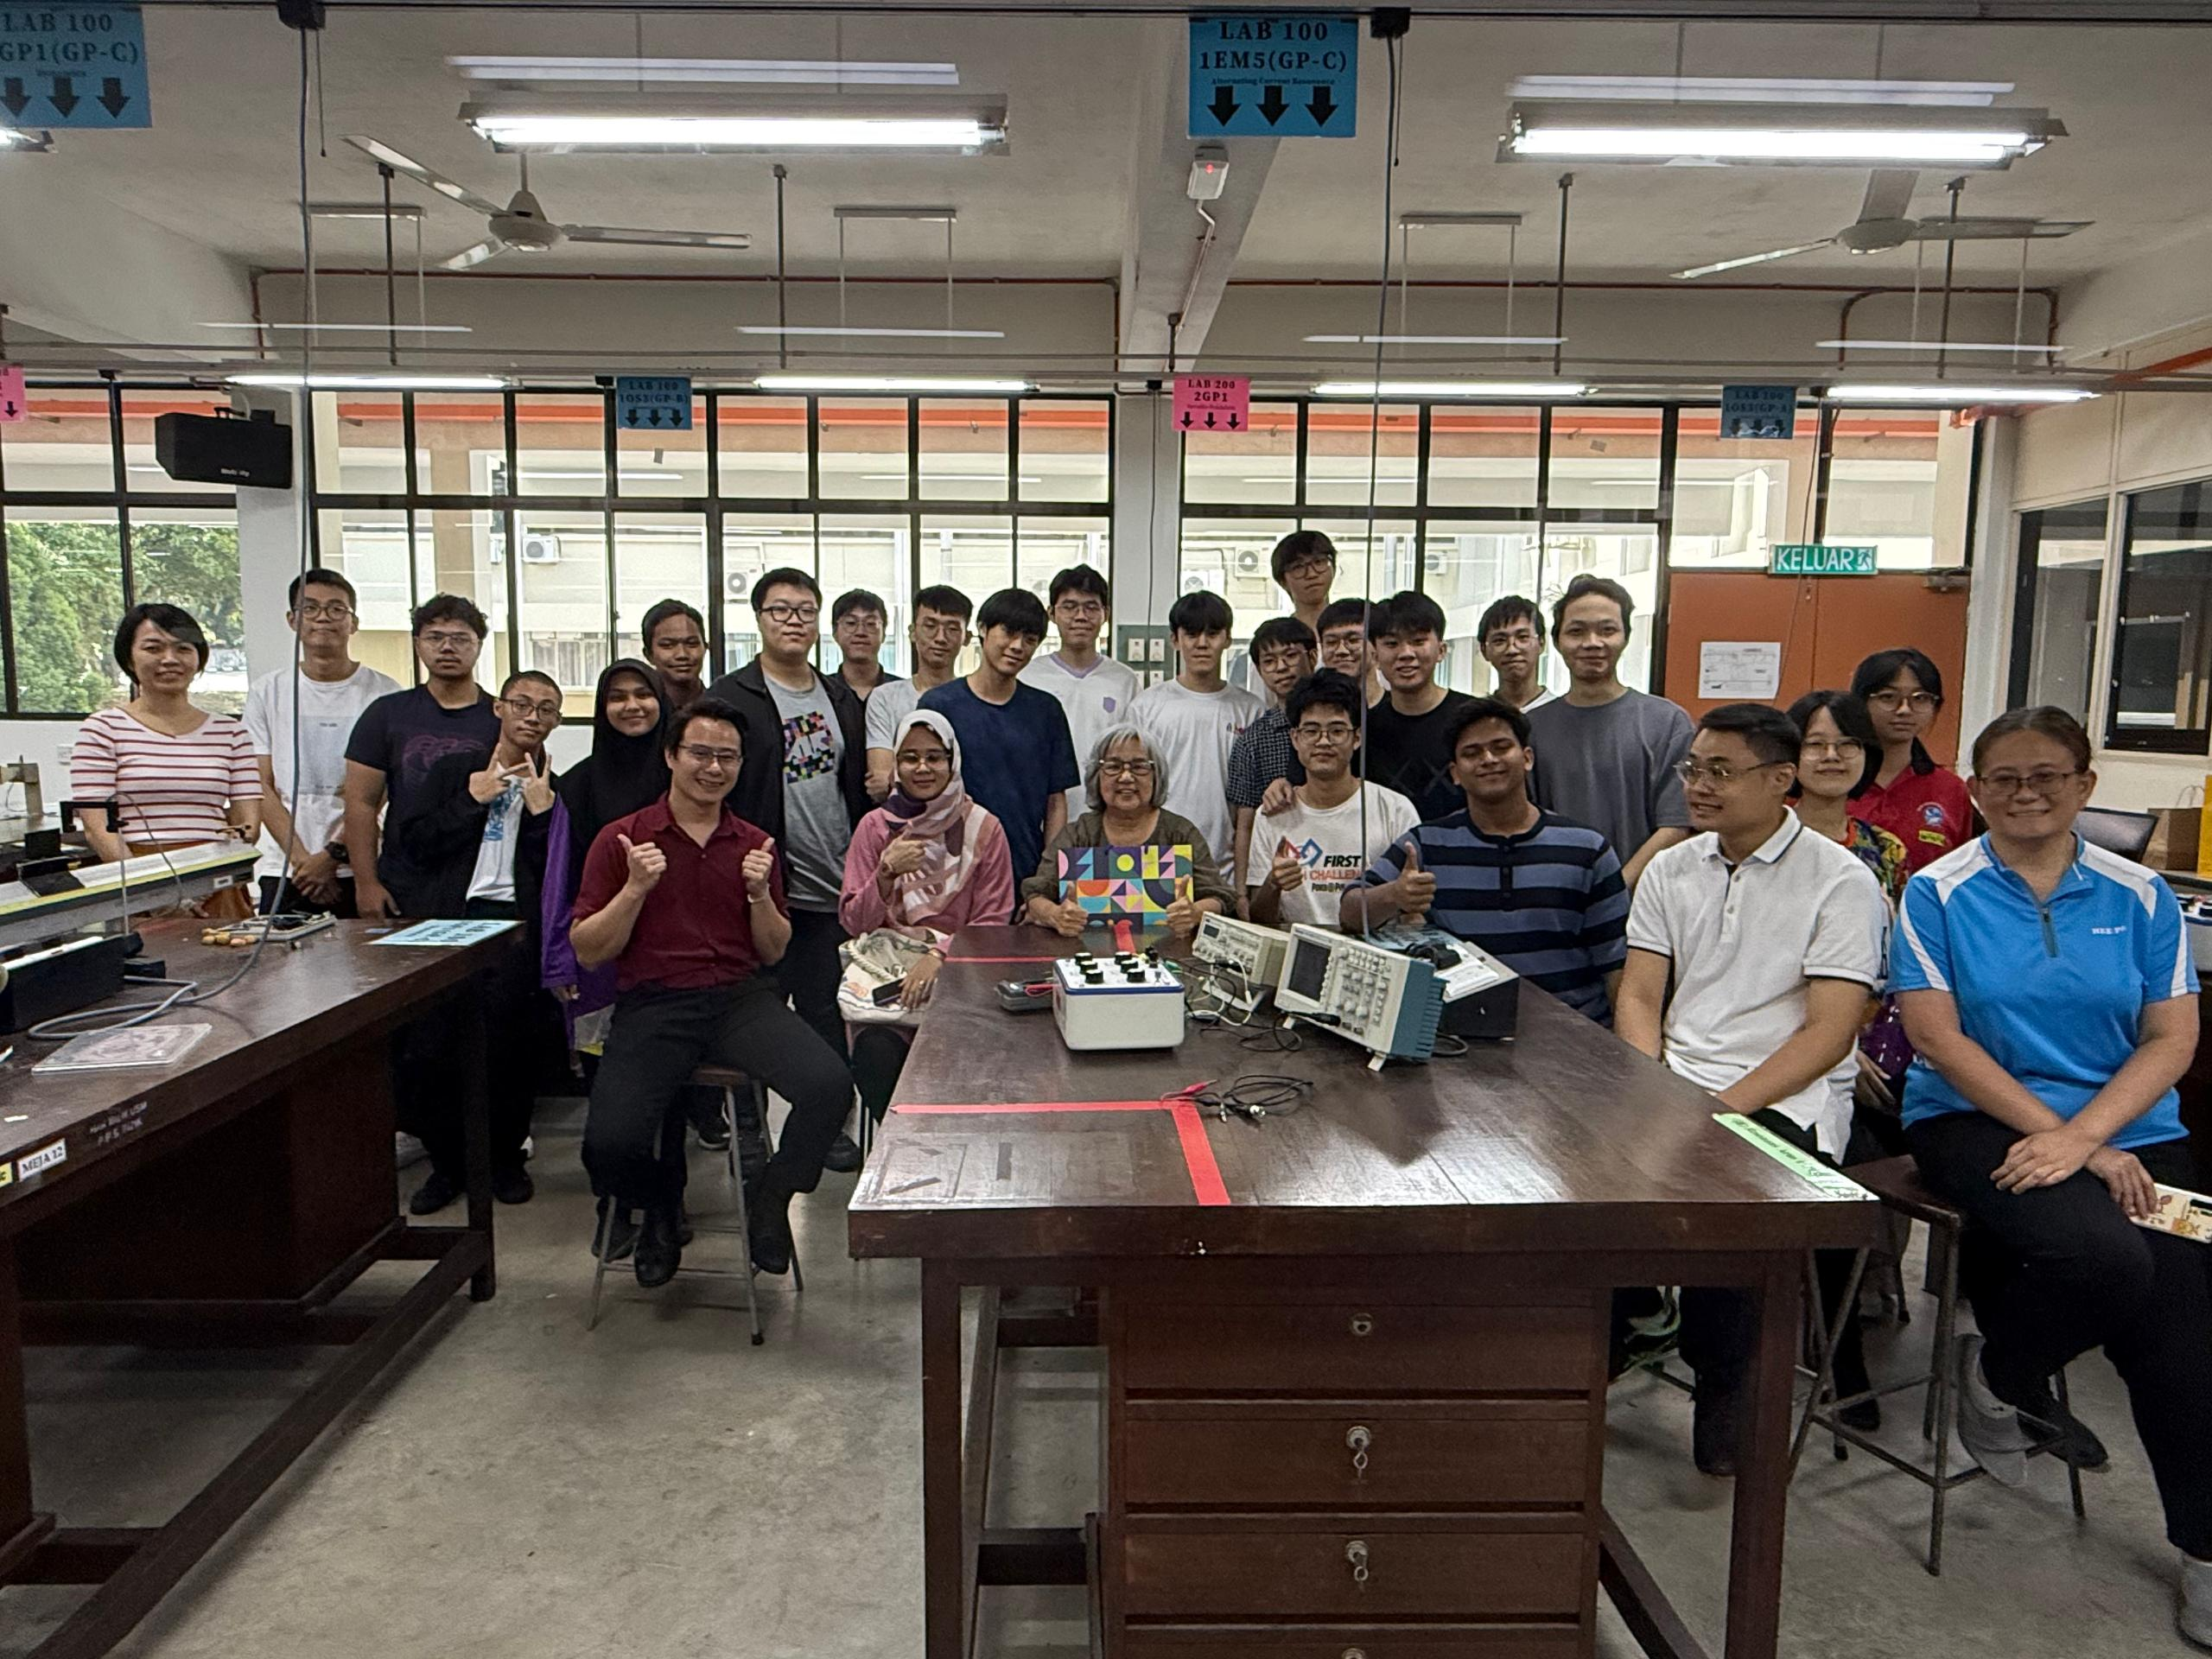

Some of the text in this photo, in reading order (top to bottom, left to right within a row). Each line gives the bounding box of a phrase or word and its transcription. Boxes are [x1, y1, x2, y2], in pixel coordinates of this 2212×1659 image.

[3, 13, 113, 33] LAB 100
[1219, 21, 1328, 41] LAB 100
[1199, 50, 1347, 73] 1EM5(GP-C)
[628, 381, 653, 391] LAB
[1188, 379, 1236, 389] LAB 200
[1194, 391, 1228, 403] 2GP1
[1777, 548, 1855, 571] KELUAR
[1324, 855, 1362, 868] FIRST
[1309, 868, 1363, 880] CHALLEN
[22, 1146, 64, 1174] MEJA 12
